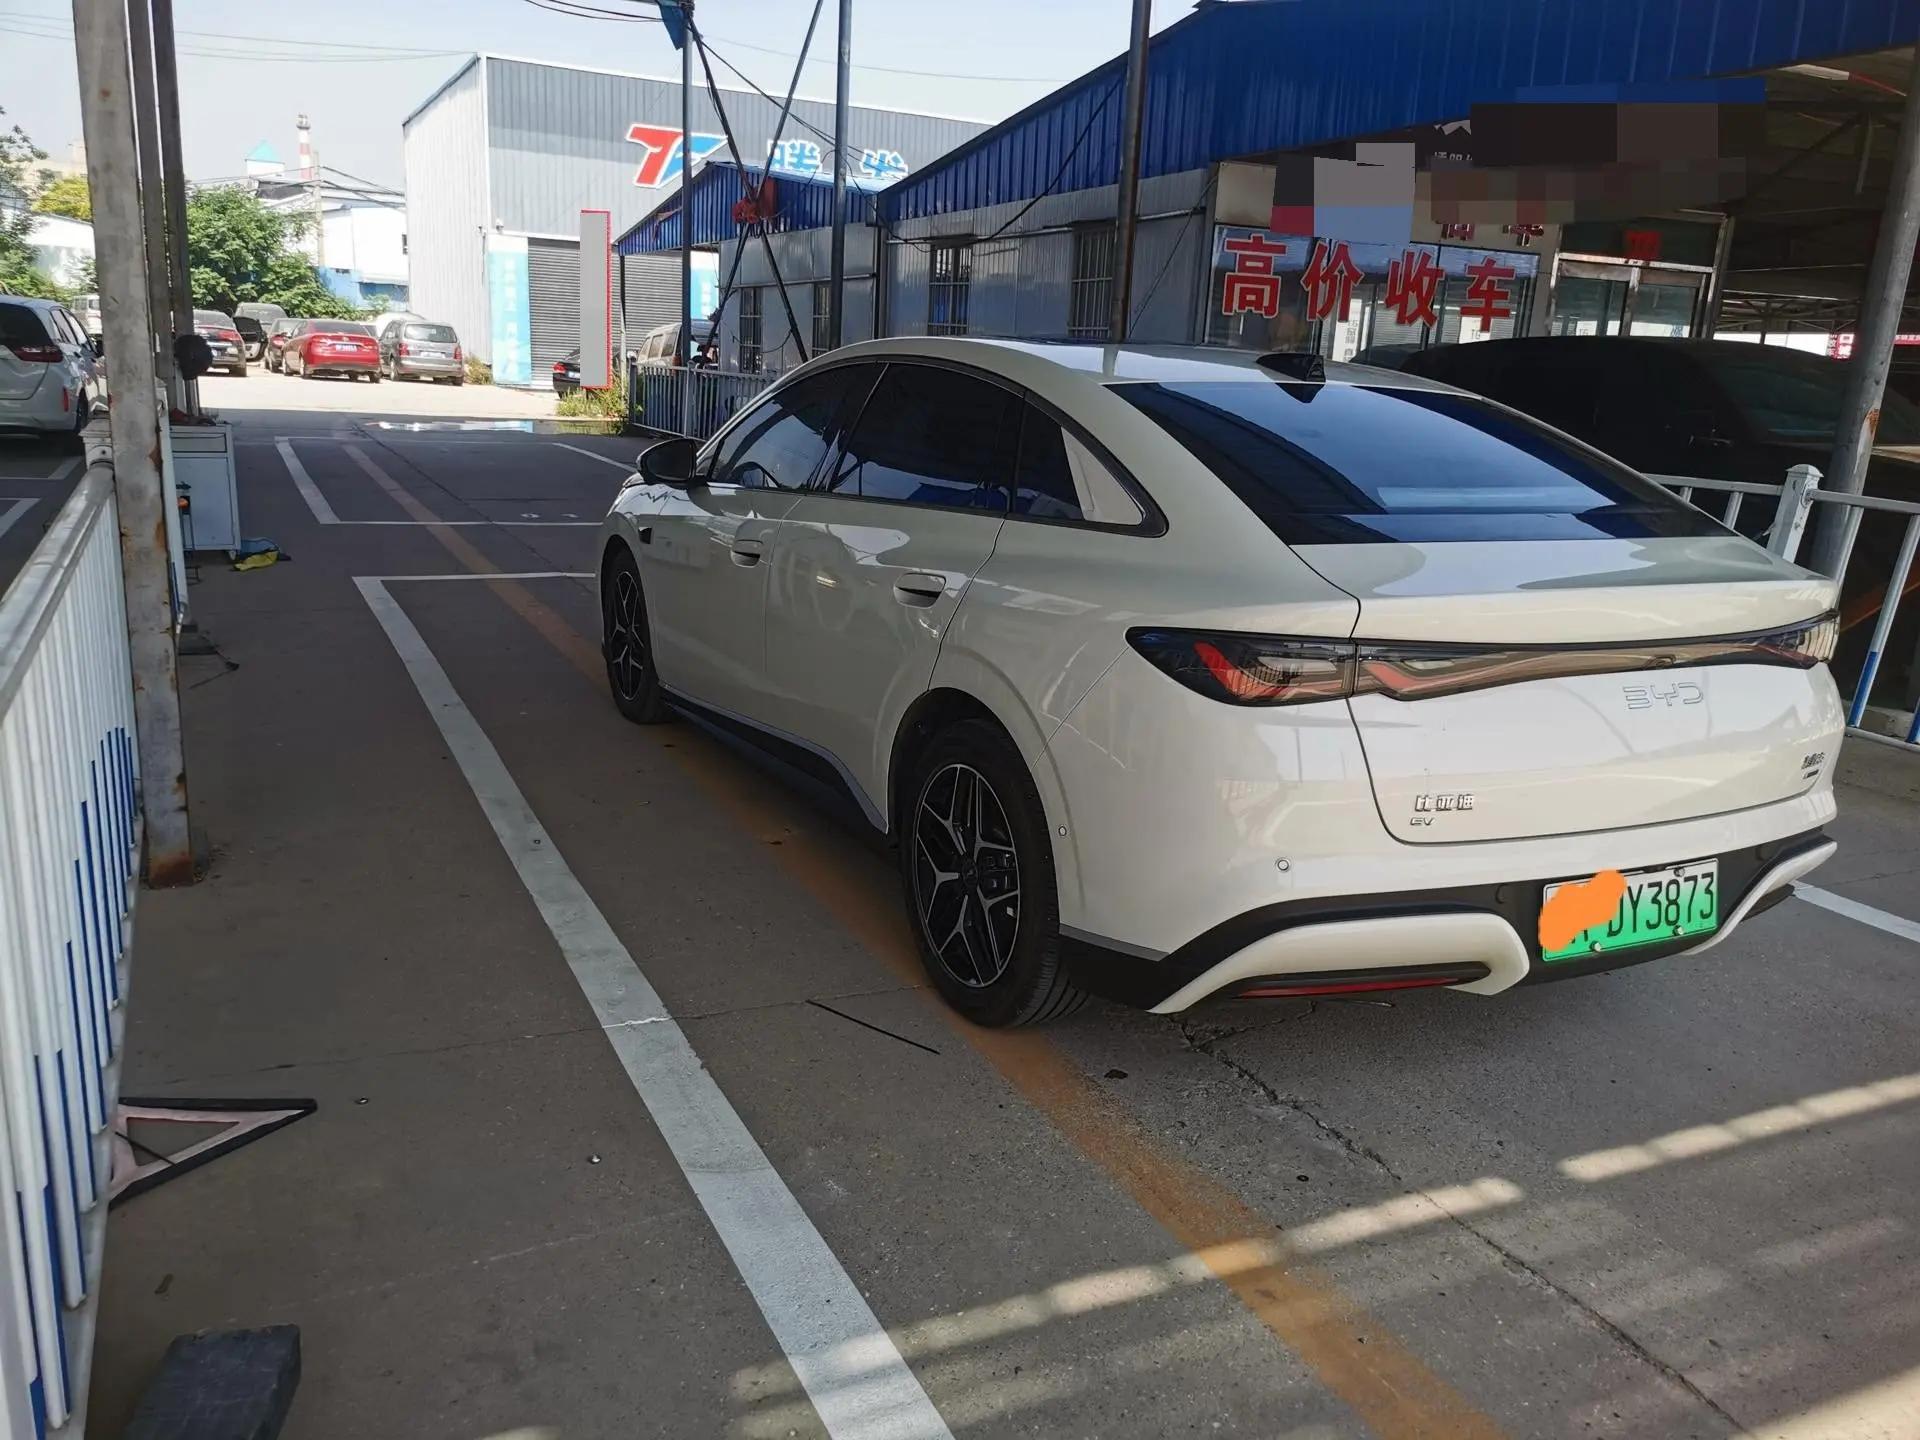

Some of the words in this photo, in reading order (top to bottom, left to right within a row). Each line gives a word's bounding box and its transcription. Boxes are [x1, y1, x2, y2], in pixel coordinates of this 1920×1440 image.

[1222, 233, 1516, 332] 高价收车
[1622, 681, 1704, 710] BYD
[1414, 793, 1475, 812] 比亚迪
[1409, 816, 1435, 826] EV
[1565, 871, 1715, 944] DY3873
